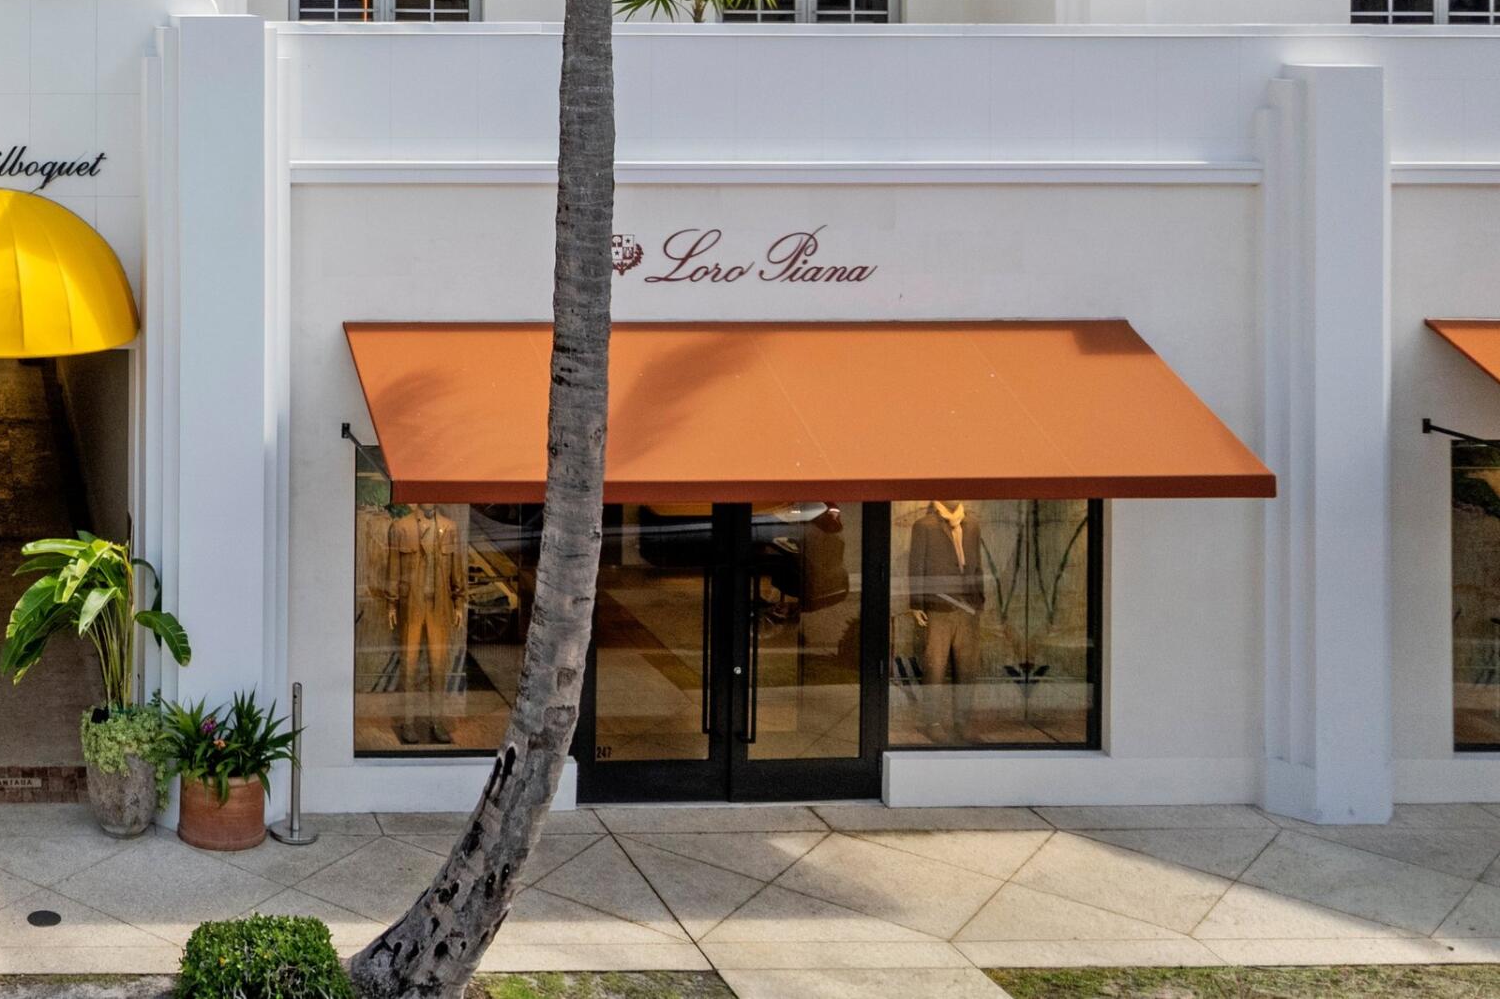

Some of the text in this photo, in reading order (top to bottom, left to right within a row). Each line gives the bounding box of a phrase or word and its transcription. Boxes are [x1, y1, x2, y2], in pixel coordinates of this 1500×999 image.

[644, 224, 878, 283] Loro Piana
[596, 745, 613, 759] 247
